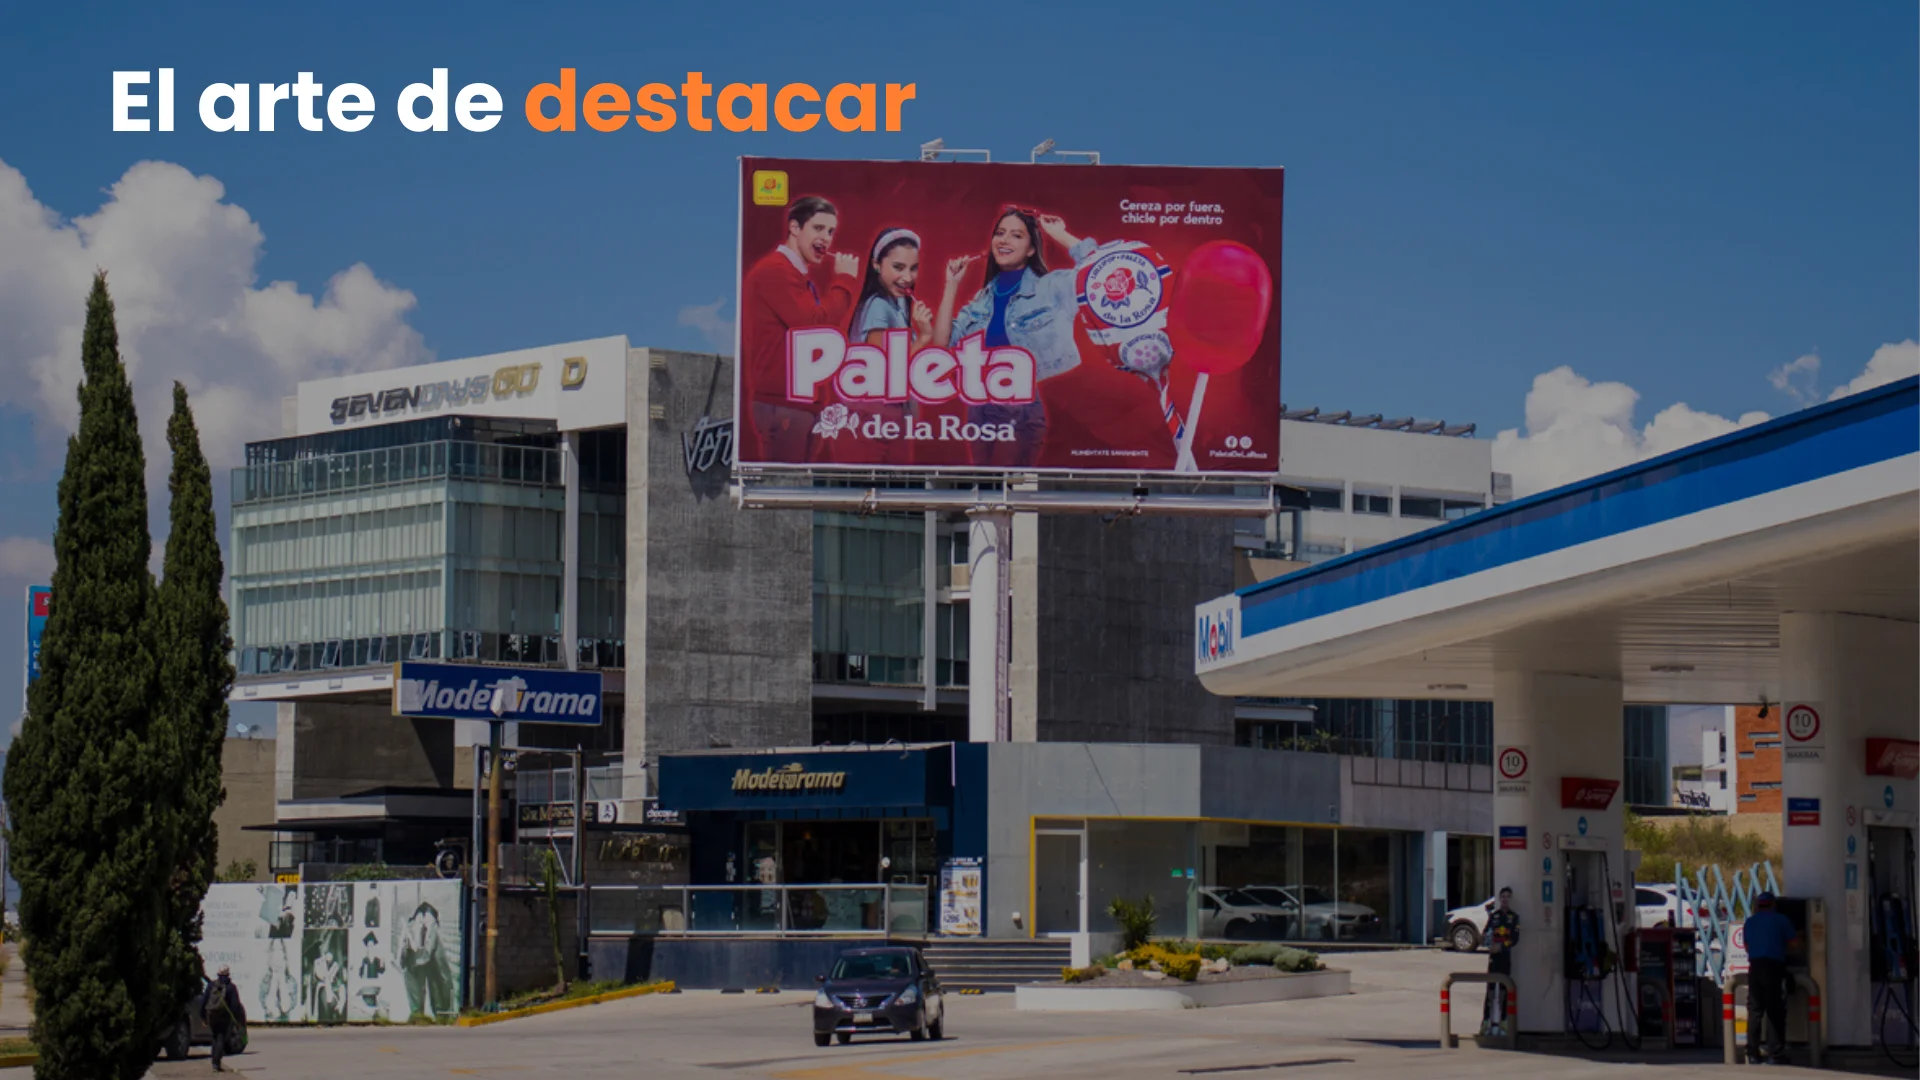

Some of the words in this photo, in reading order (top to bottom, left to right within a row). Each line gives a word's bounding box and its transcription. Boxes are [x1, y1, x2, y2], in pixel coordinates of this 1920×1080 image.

[1119, 199, 1162, 212] Cereza
[1165, 202, 1185, 214] por
[1121, 211, 1156, 224] chicle
[1159, 215, 1180, 226] por
[1183, 213, 1223, 225] dentro
[788, 328, 1035, 404] Paleta
[862, 414, 900, 439] de
[903, 415, 933, 440] la
[938, 416, 1016, 441] Rosa
[1198, 608, 1234, 660] Mobil
[1793, 713, 1812, 728] 10
[1505, 755, 1520, 768] 10
